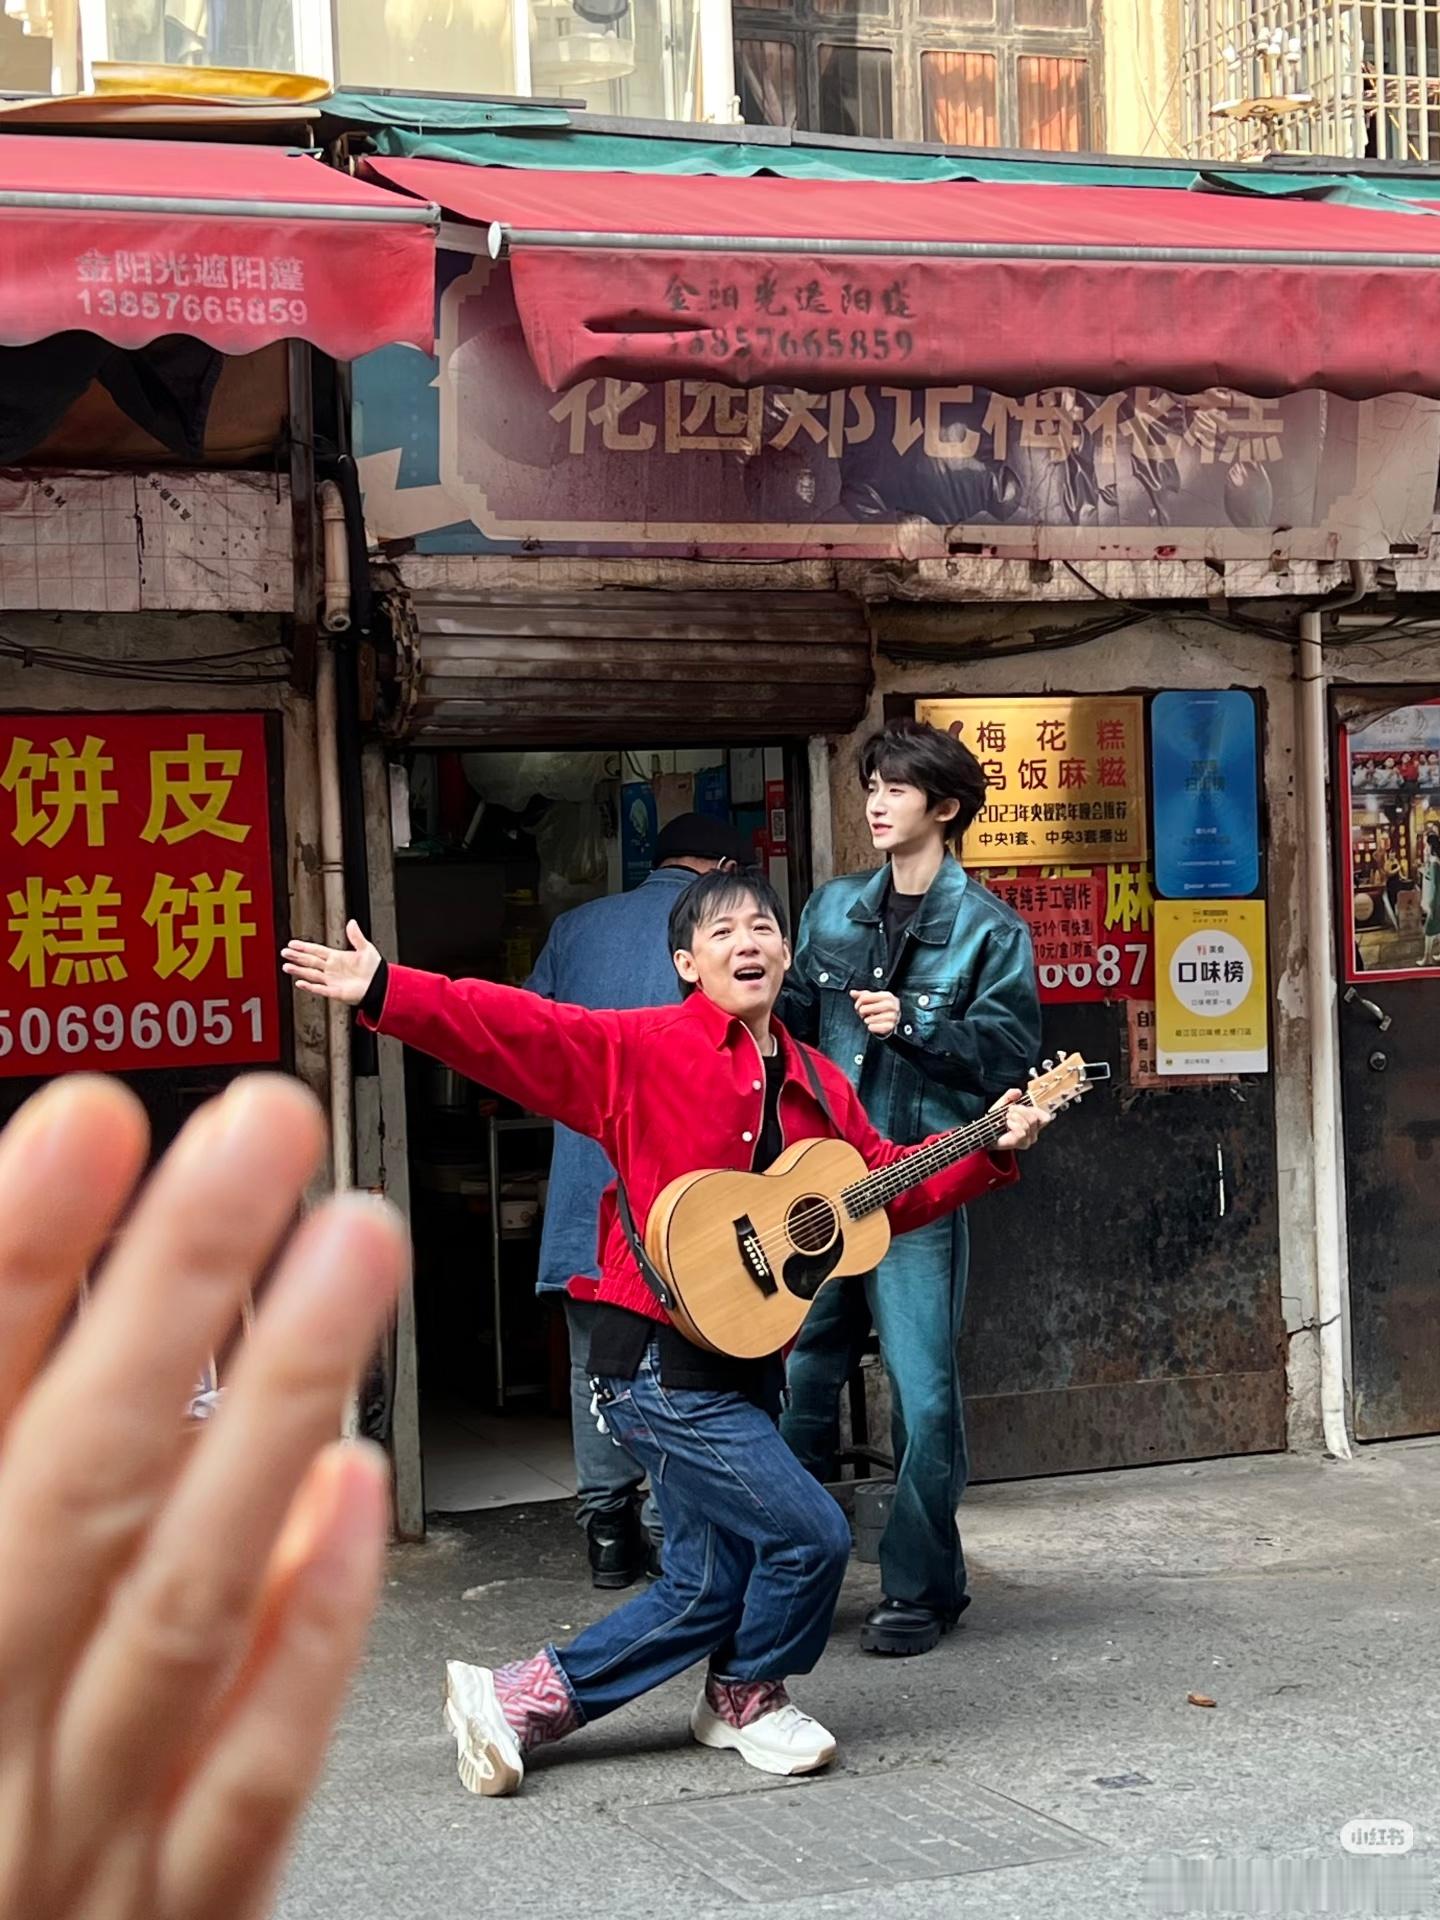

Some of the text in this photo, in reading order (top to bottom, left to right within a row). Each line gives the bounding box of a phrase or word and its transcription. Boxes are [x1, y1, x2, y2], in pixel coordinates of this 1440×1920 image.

[76, 288, 308, 325] 13857665859
[976, 719, 1126, 752] 梅花糕
[7, 869, 257, 988] 糕饼
[1178, 960, 1244, 983] 口味榜
